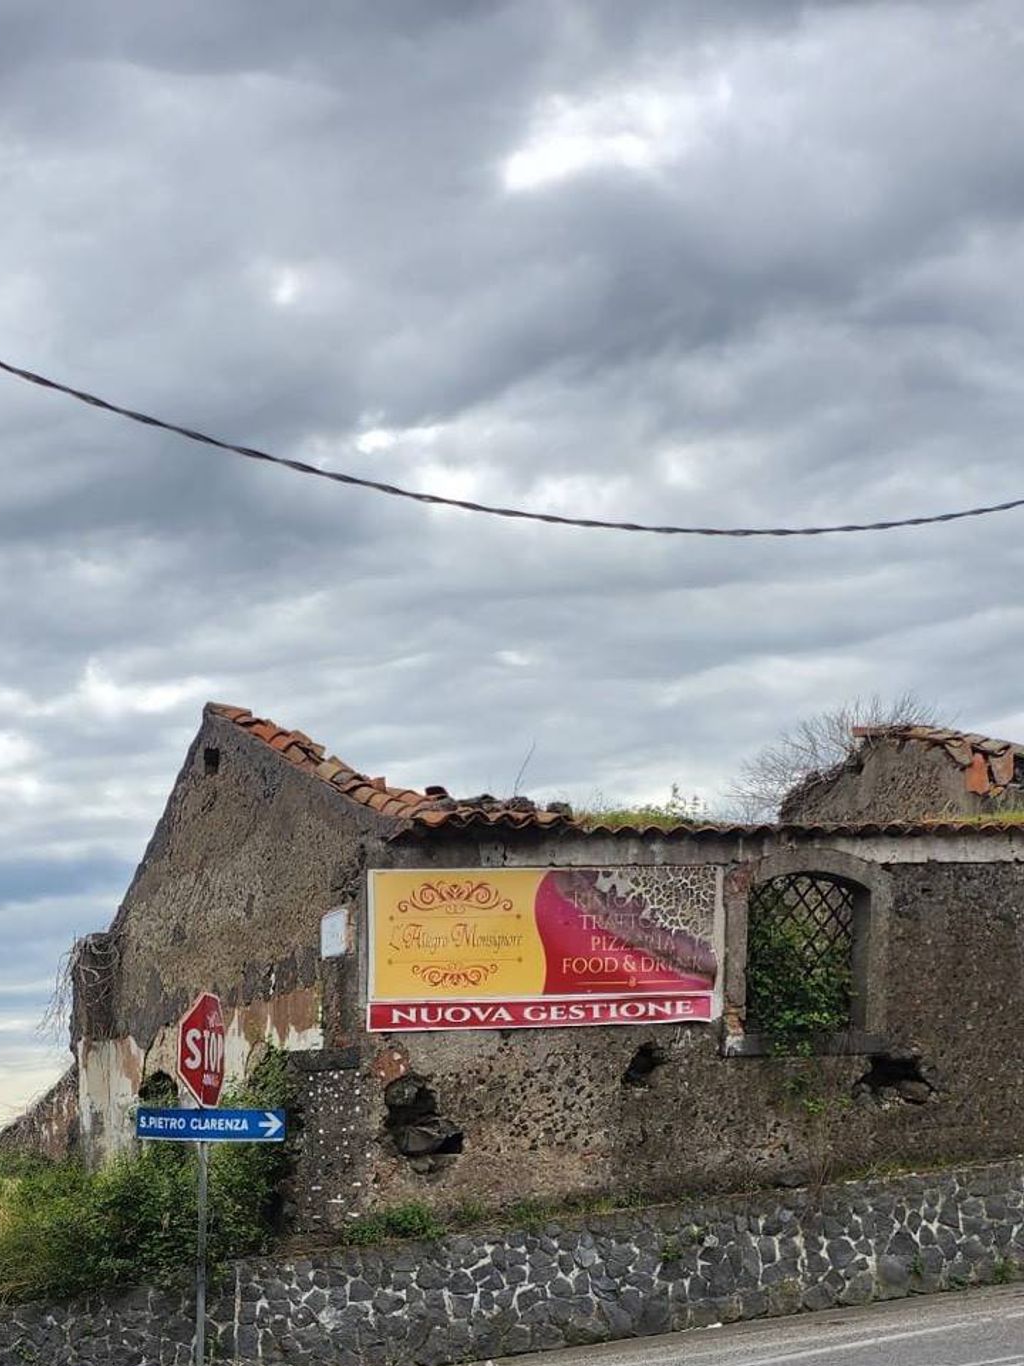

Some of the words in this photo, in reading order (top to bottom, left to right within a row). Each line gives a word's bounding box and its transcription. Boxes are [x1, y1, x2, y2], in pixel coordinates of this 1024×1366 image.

[578, 914, 680, 930] TRATTO
[562, 957, 618, 974] FOOD
[622, 955, 637, 973] &
[391, 1005, 514, 1024] NUOVA
[523, 1000, 695, 1022] GESTIONE
[184, 1028, 224, 1073] STOP
[139, 1115, 186, 1130] S.PIETRO
[190, 1117, 249, 1131] CLARENZA
